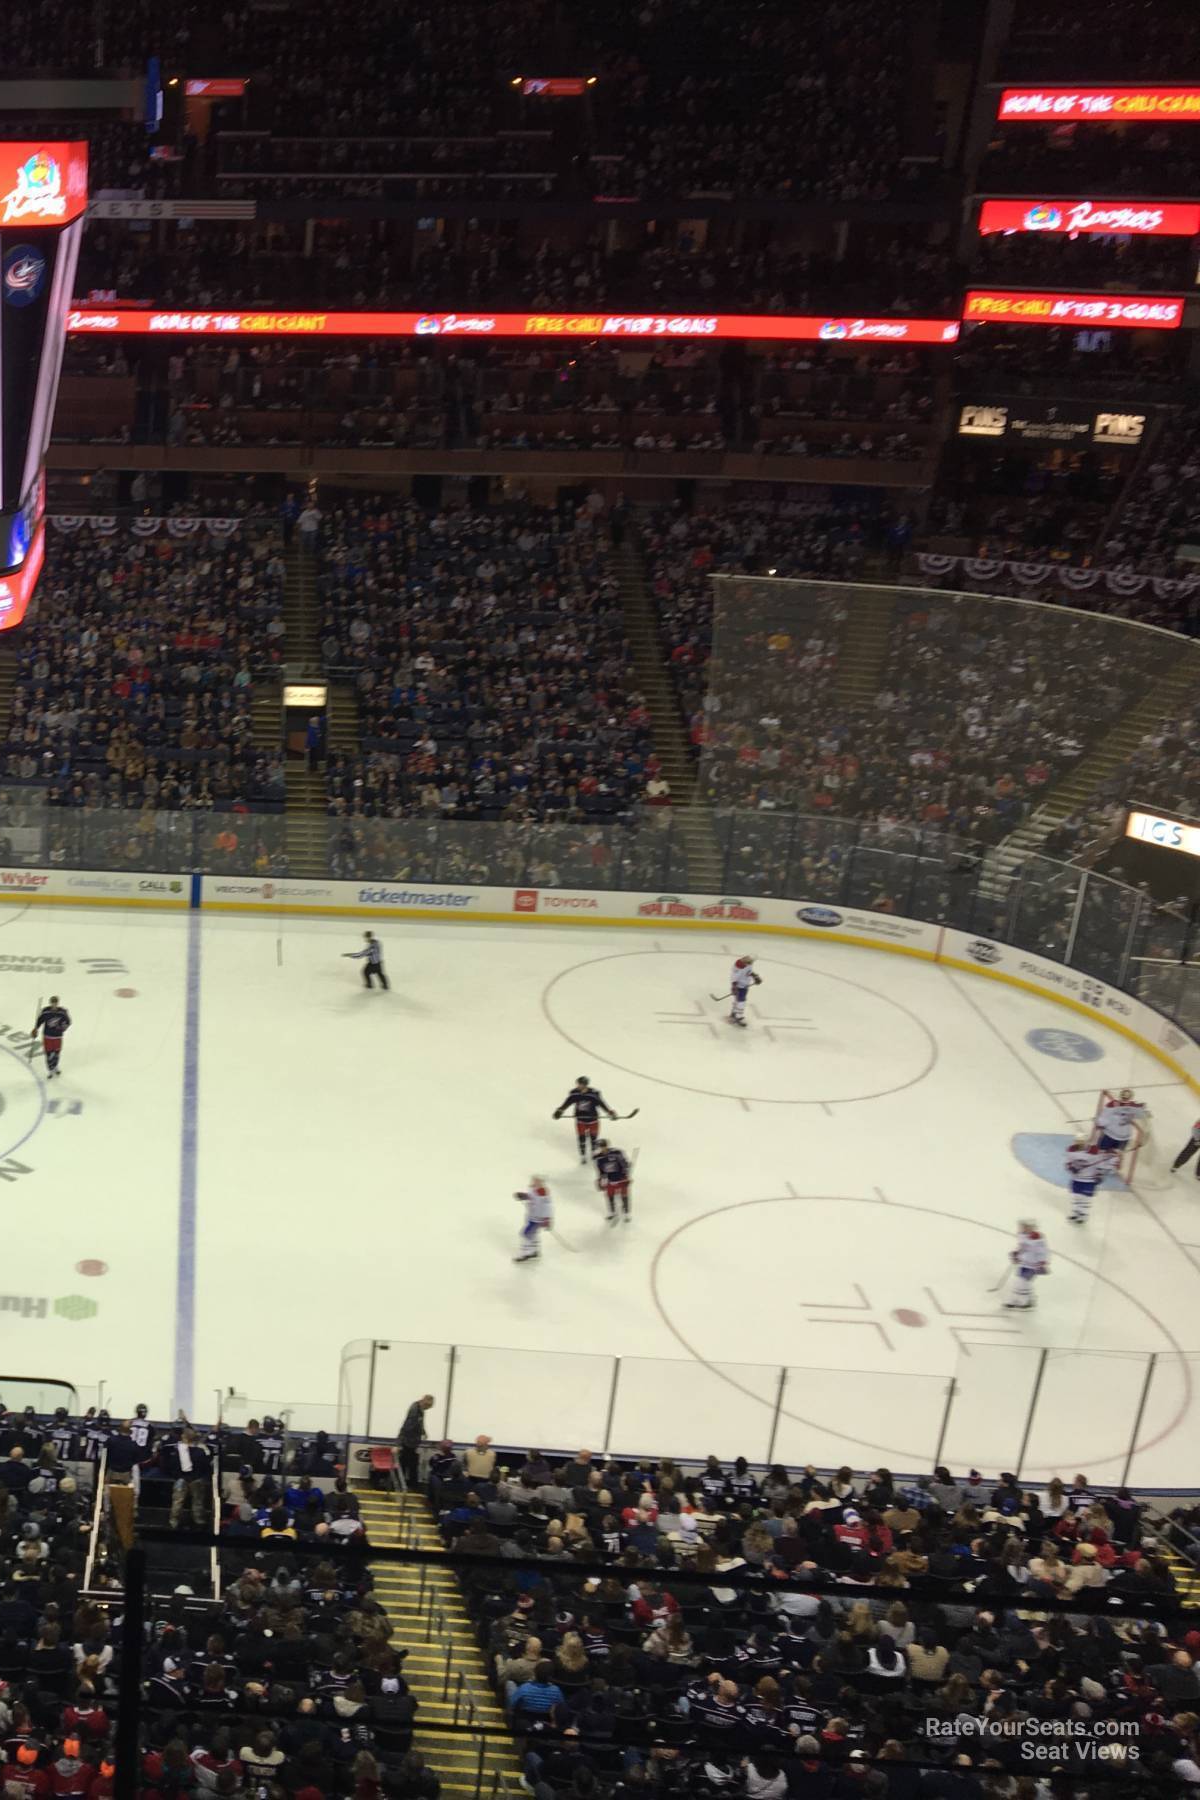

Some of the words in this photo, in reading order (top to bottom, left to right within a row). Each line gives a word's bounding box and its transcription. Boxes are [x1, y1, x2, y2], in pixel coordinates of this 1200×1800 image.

[0, 871, 50, 886] Wyler
[358, 887, 473, 906] ticketmaster
[543, 896, 599, 909] TOYOTA
